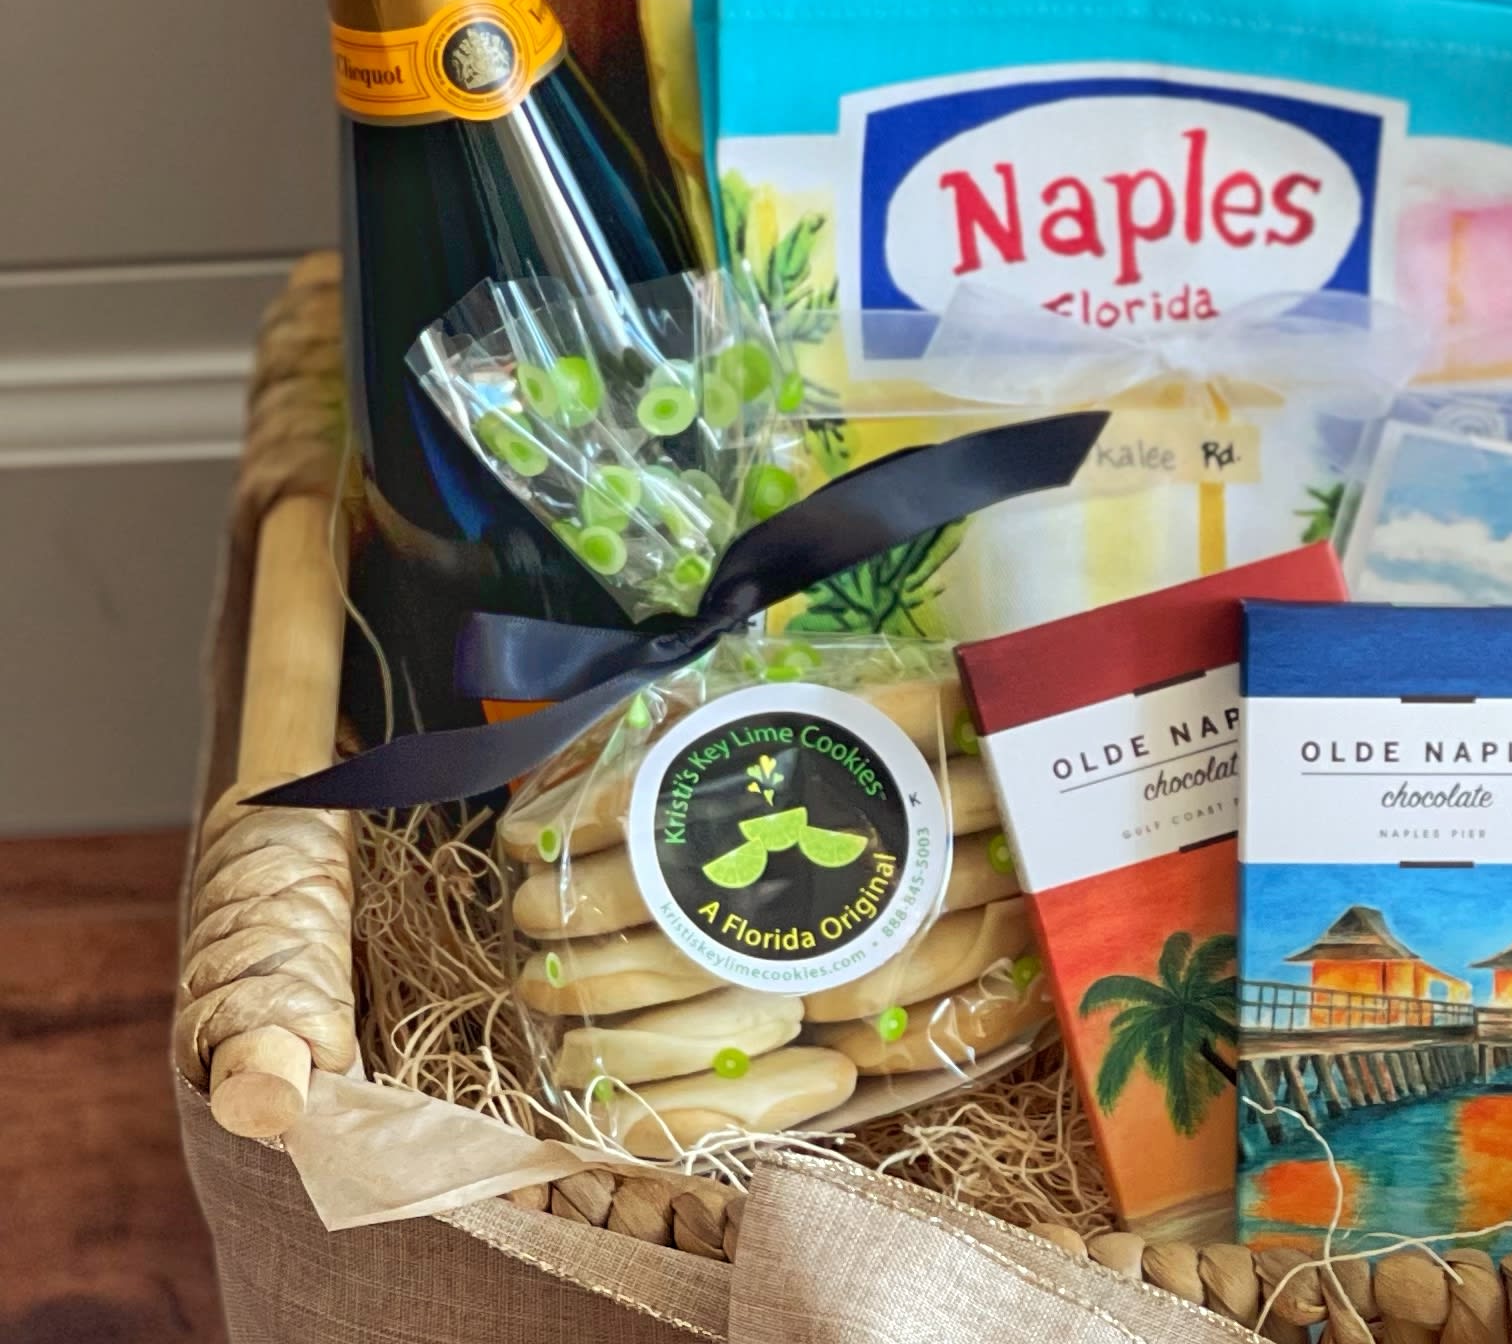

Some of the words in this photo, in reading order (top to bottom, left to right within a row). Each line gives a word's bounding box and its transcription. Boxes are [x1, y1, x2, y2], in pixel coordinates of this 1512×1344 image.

[939, 127, 1322, 285] Naples
[1053, 735, 1150, 780] OLDE
[1170, 707, 1240, 746] NAP
[1300, 740, 1400, 764] OLDE
[664, 768, 700, 845] Kristi's
[687, 738, 731, 772] Key
[730, 725, 794, 748] Lime
[1144, 751, 1240, 801] chocolat
[1380, 780, 1494, 809] chocolate
[1379, 828, 1440, 839] NAPLES
[1451, 828, 1487, 839] PIER
[698, 901, 722, 924] A
[722, 913, 817, 951] Florida
[820, 852, 898, 940] Original
